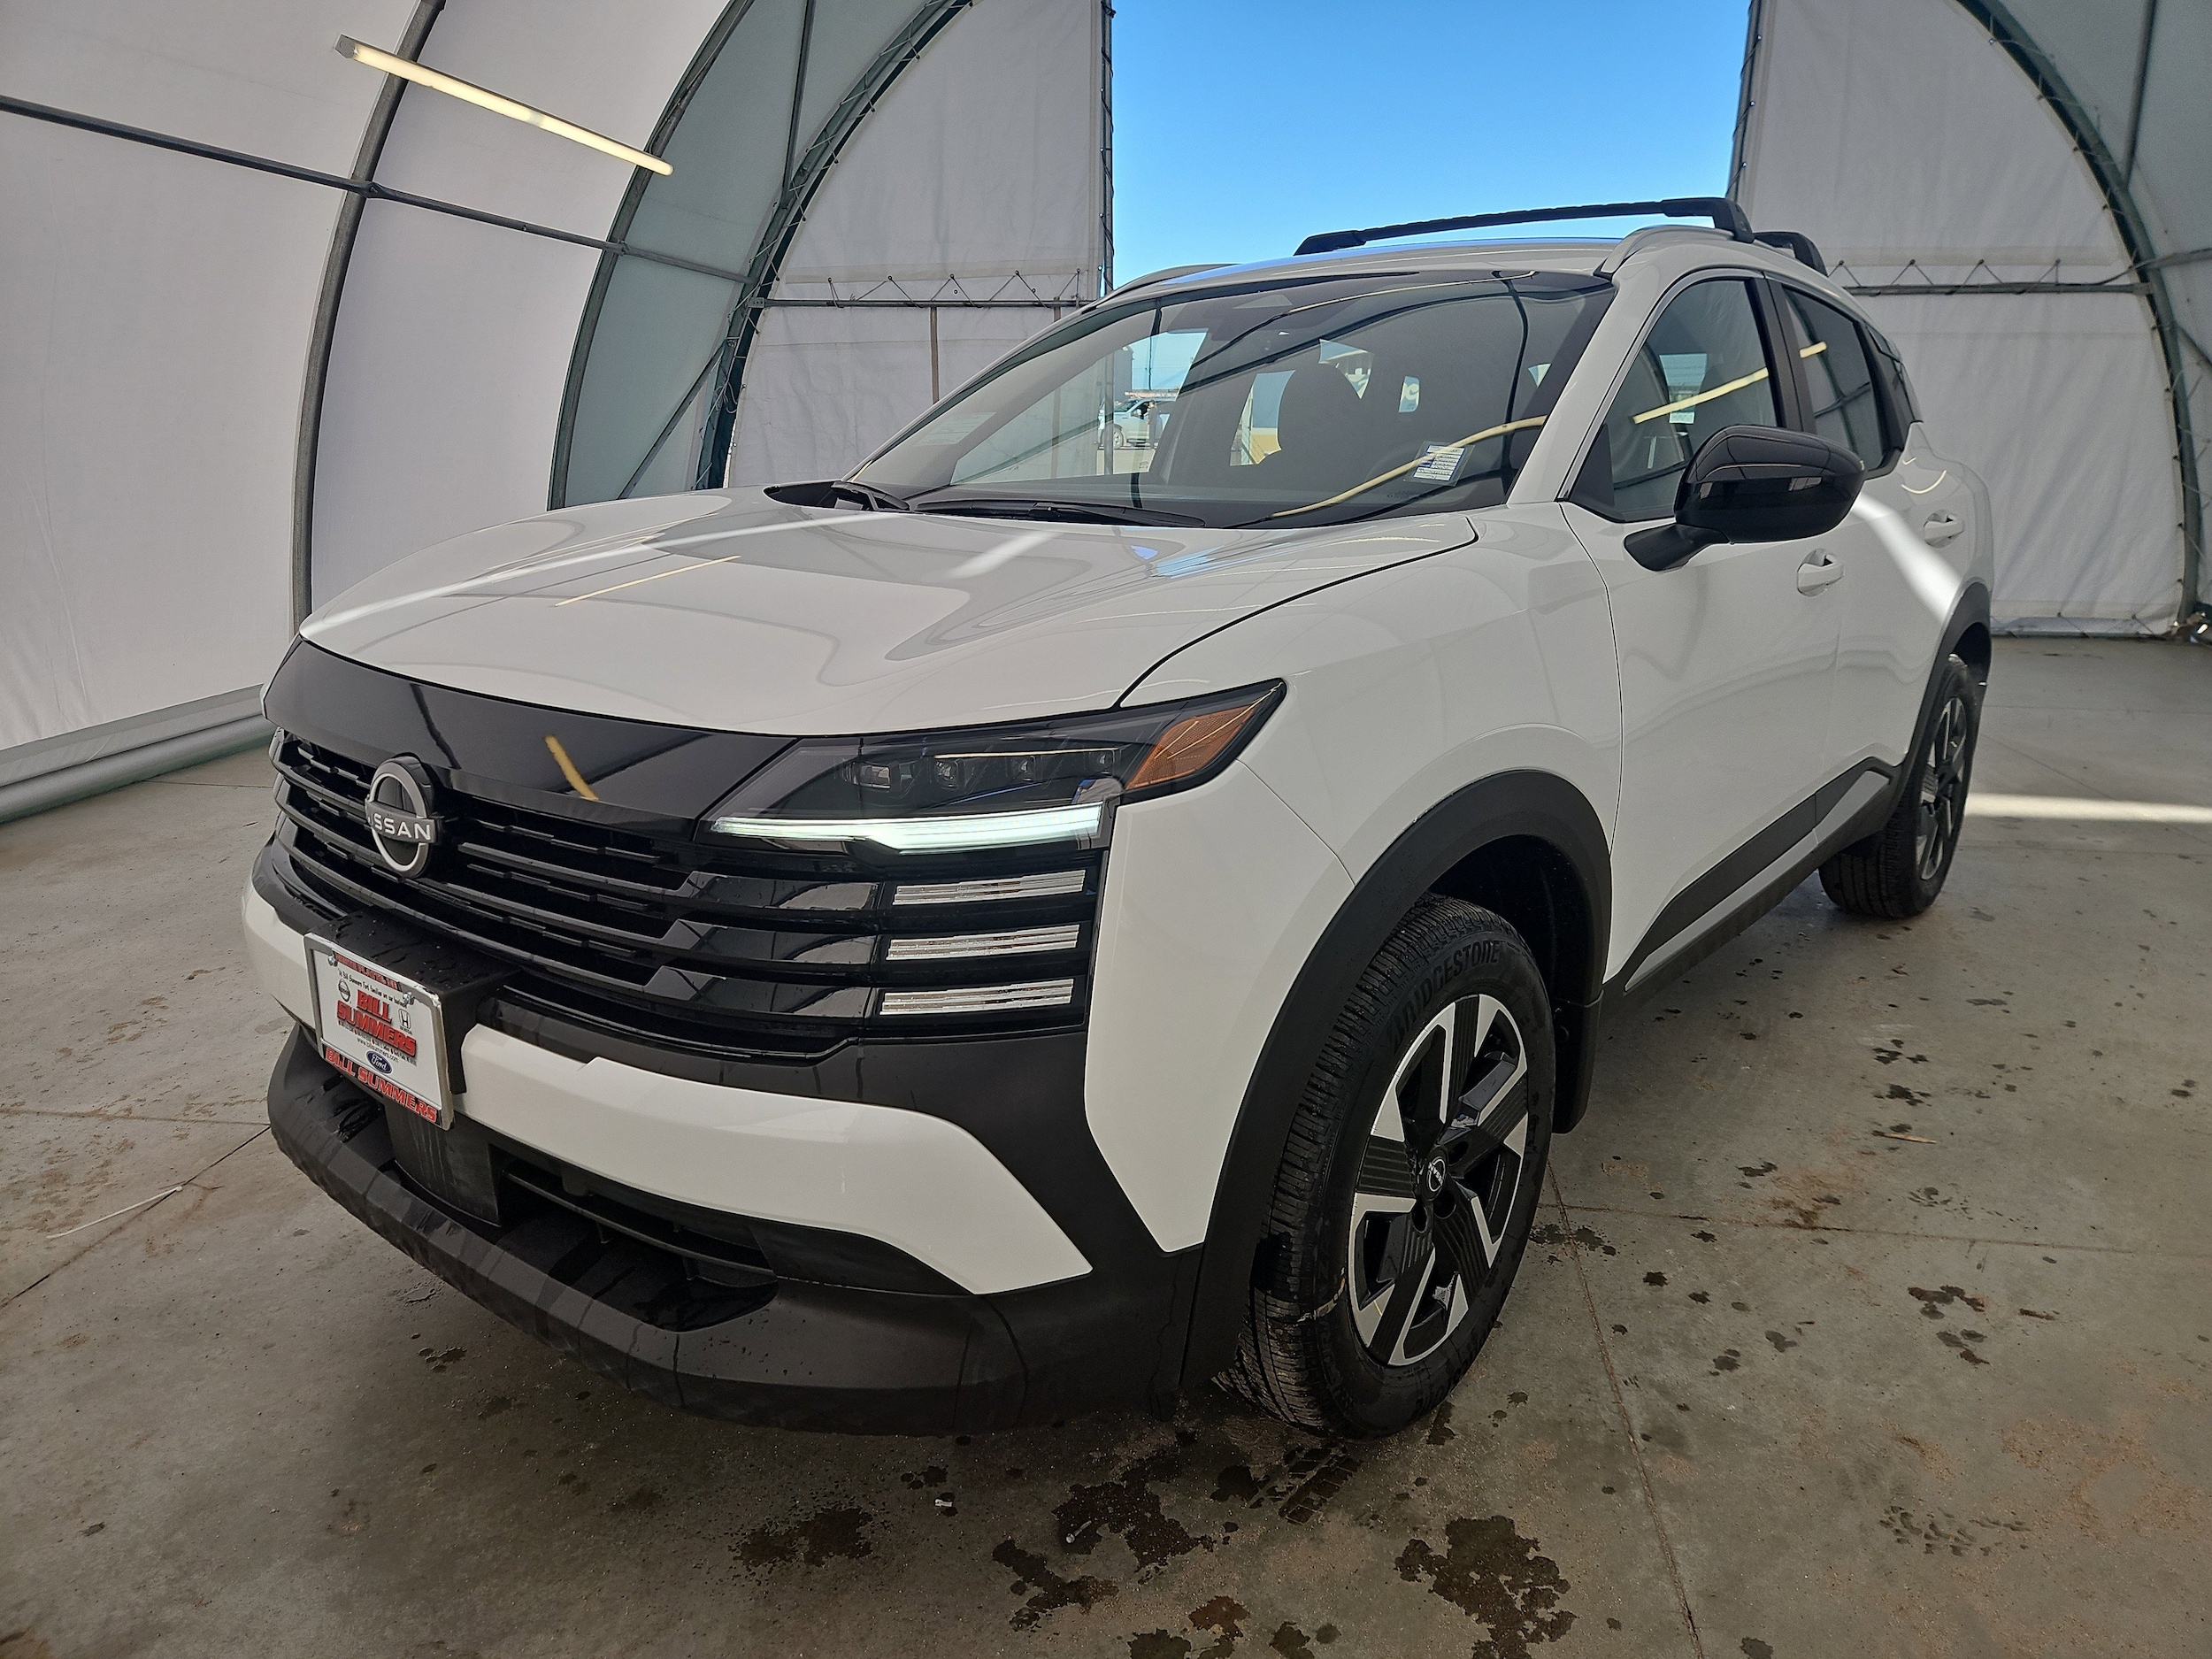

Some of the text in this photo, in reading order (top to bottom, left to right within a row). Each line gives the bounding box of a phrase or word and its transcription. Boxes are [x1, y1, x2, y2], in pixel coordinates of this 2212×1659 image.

[337, 1000, 416, 1057] SUMMERS
[357, 989, 391, 1024] BILL
[1386, 940, 1499, 1053] BRIDGESTONE
[326, 1047, 437, 1123] BILL SUMMERS
